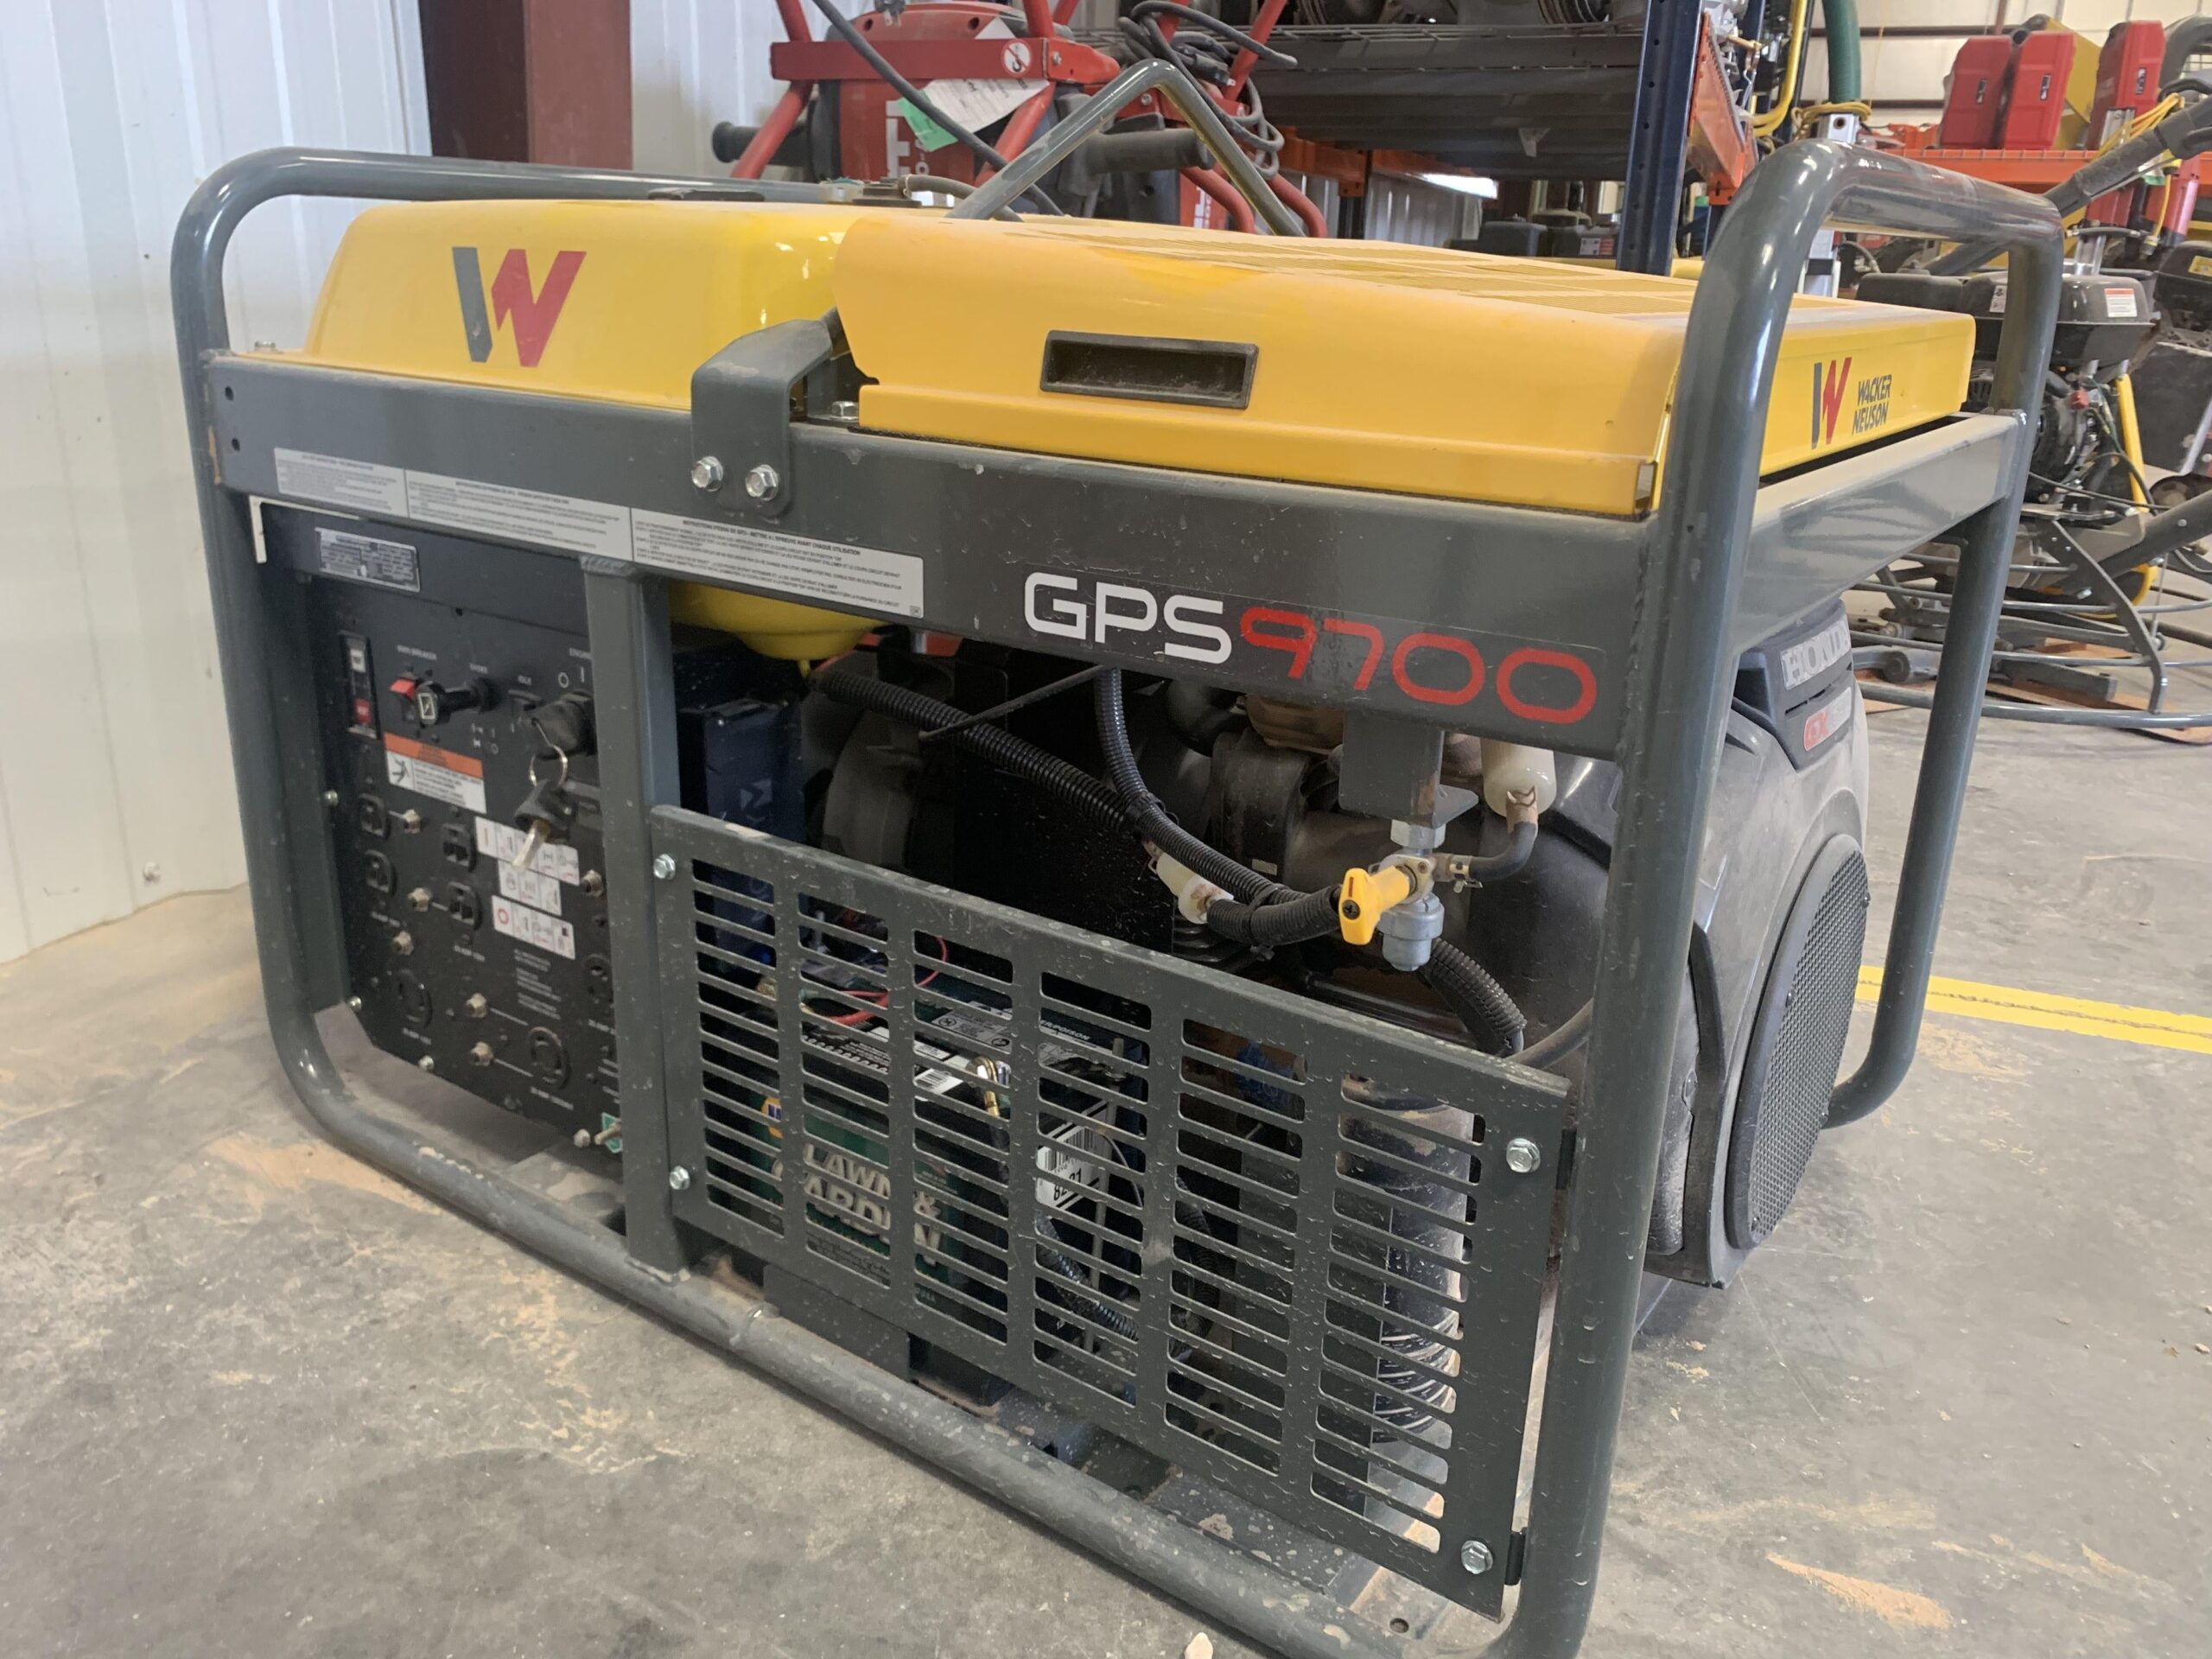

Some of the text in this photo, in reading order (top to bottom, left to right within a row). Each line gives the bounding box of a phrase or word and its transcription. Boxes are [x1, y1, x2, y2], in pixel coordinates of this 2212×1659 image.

[450, 246, 588, 369] W
[1857, 374, 1892, 406] WACKER
[1852, 401, 1890, 435] NEUSON
